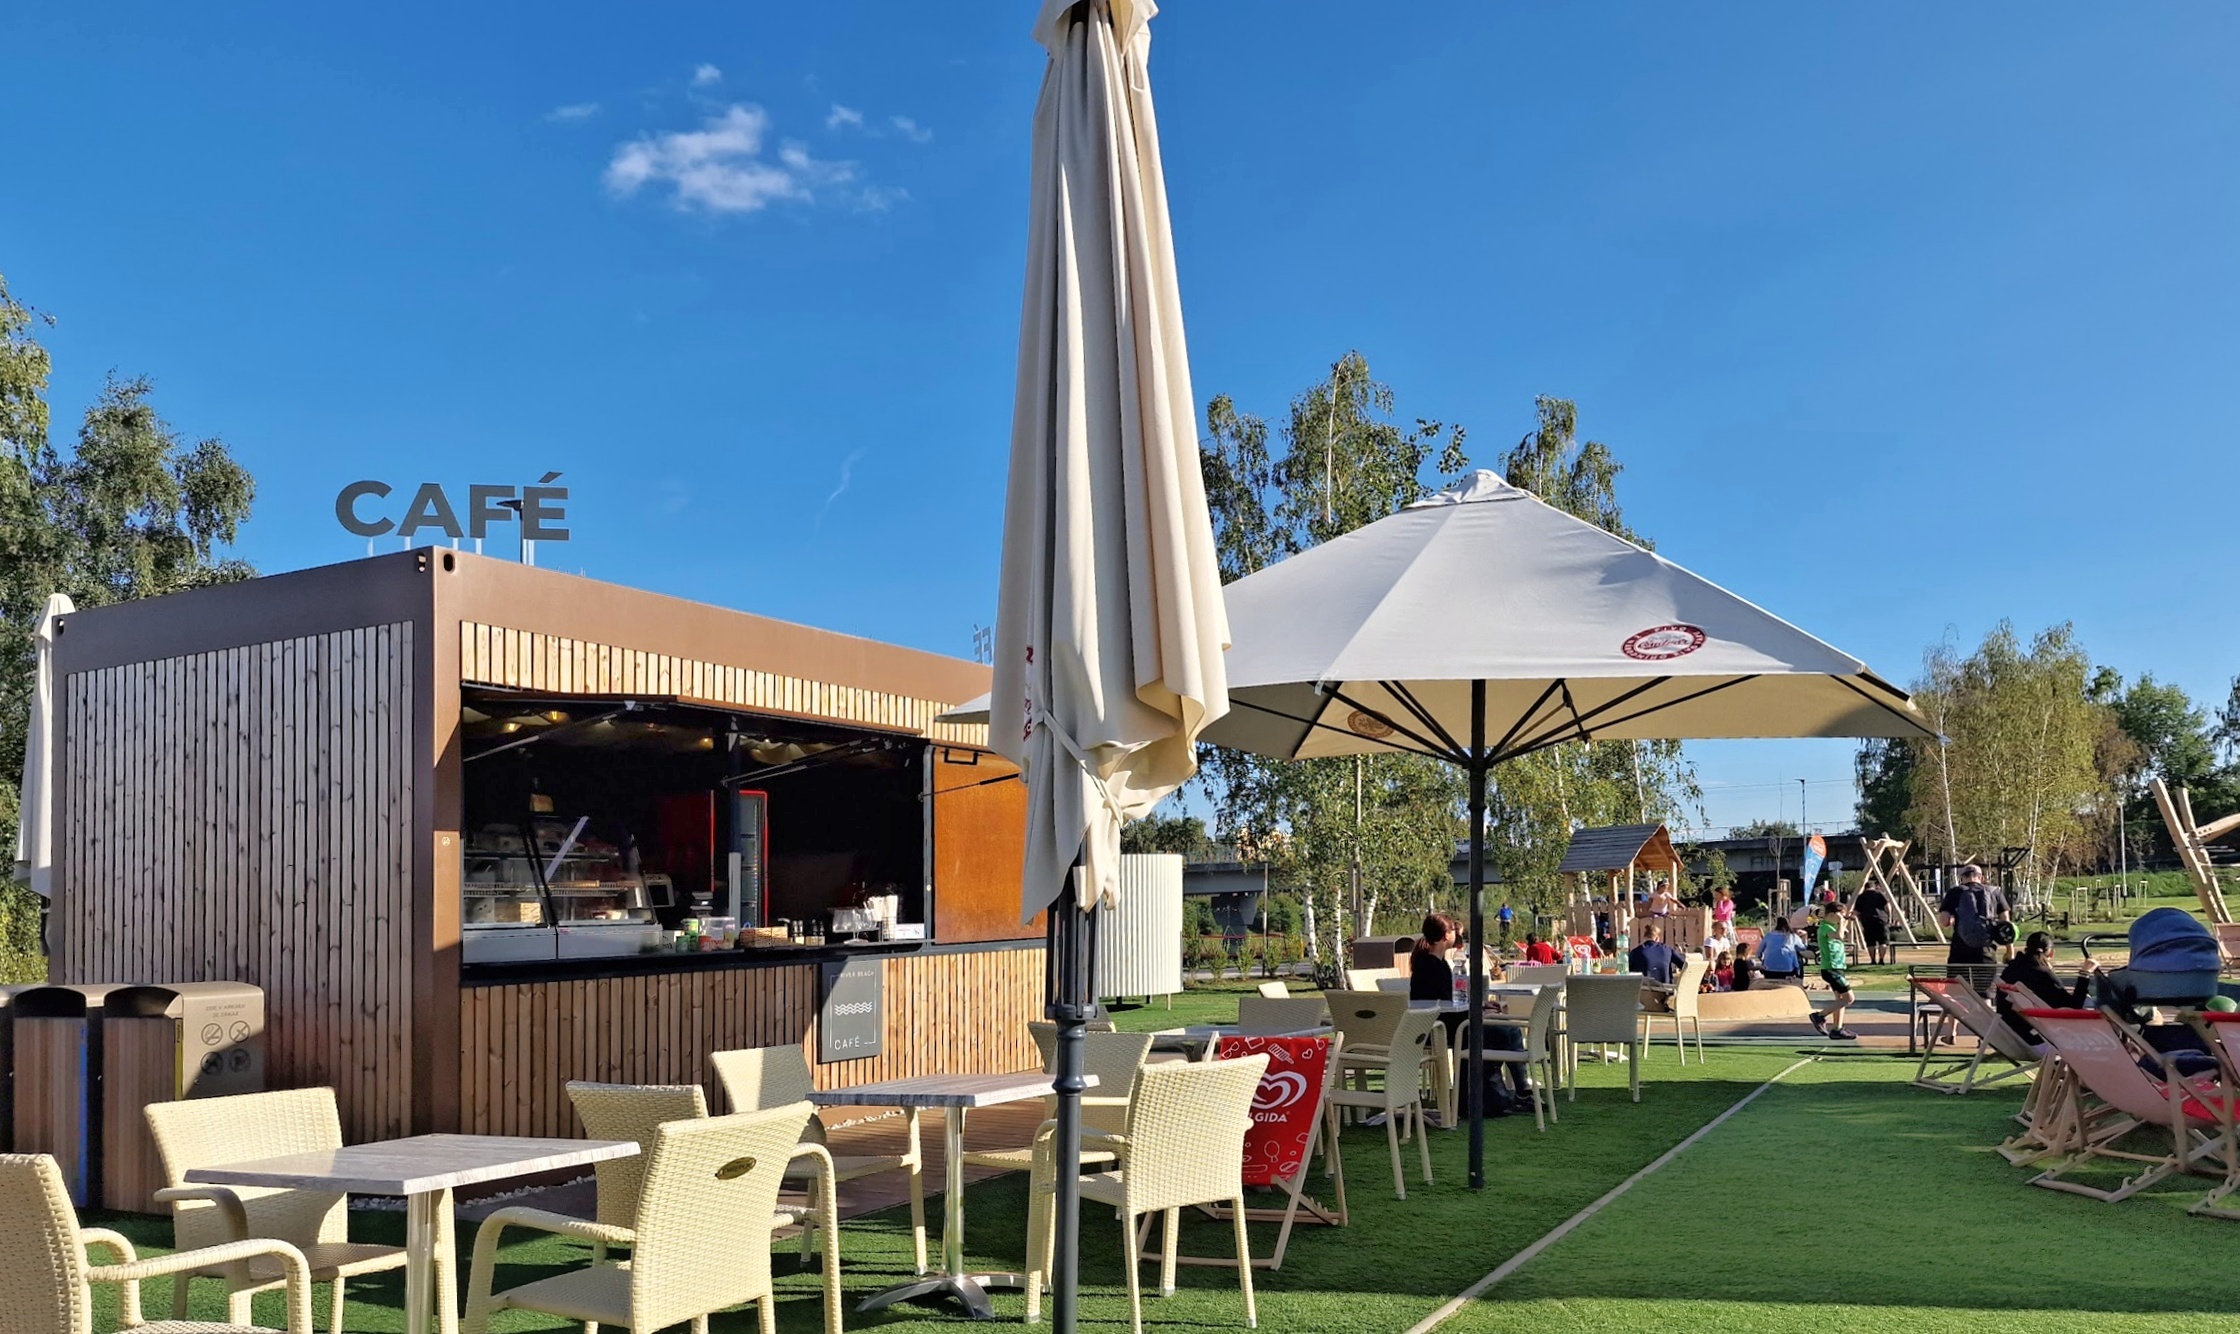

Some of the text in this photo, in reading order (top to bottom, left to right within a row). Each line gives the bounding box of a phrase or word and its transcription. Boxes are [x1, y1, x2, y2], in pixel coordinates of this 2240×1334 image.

[335, 472, 569, 540] CAFÉ
[834, 1035, 860, 1050] CAFÉ
[1249, 1112, 1288, 1123] GIDA
